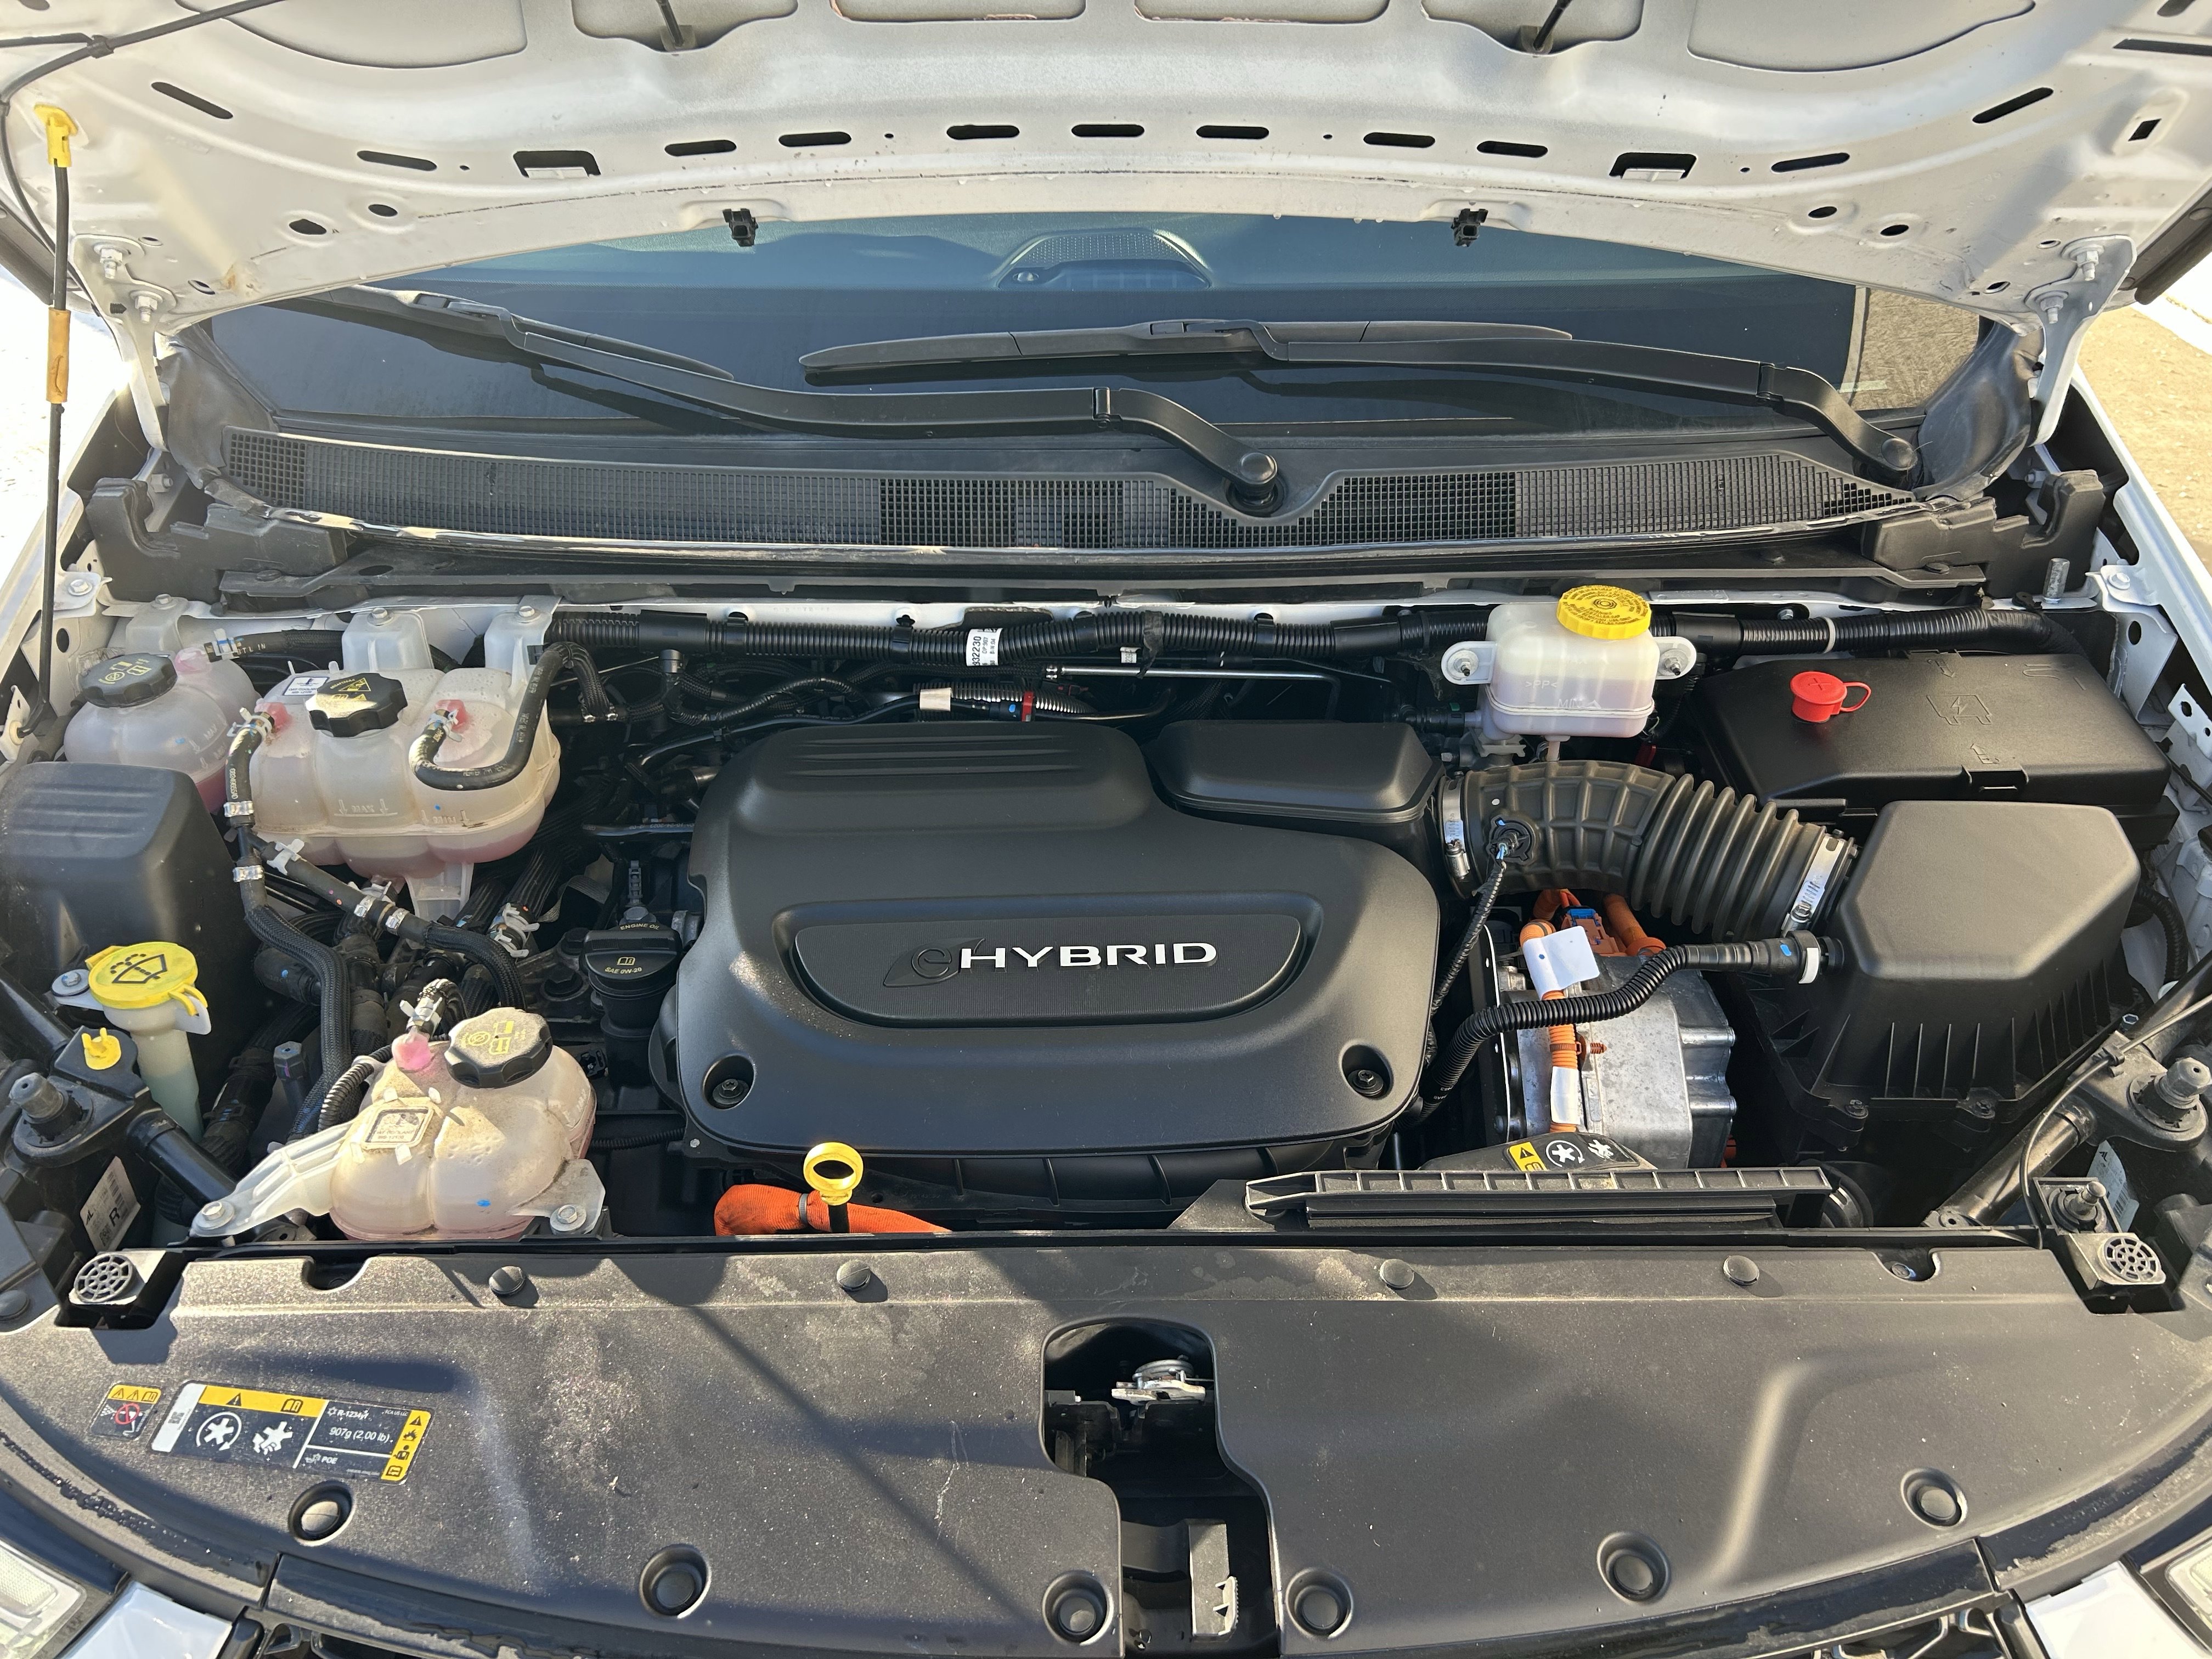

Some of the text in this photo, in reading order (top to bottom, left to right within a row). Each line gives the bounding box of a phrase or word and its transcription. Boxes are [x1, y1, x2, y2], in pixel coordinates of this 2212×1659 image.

[109, 1207, 120, 1227] R
[329, 1426, 352, 1440] 907g
[321, 1455, 338, 1464] POE
